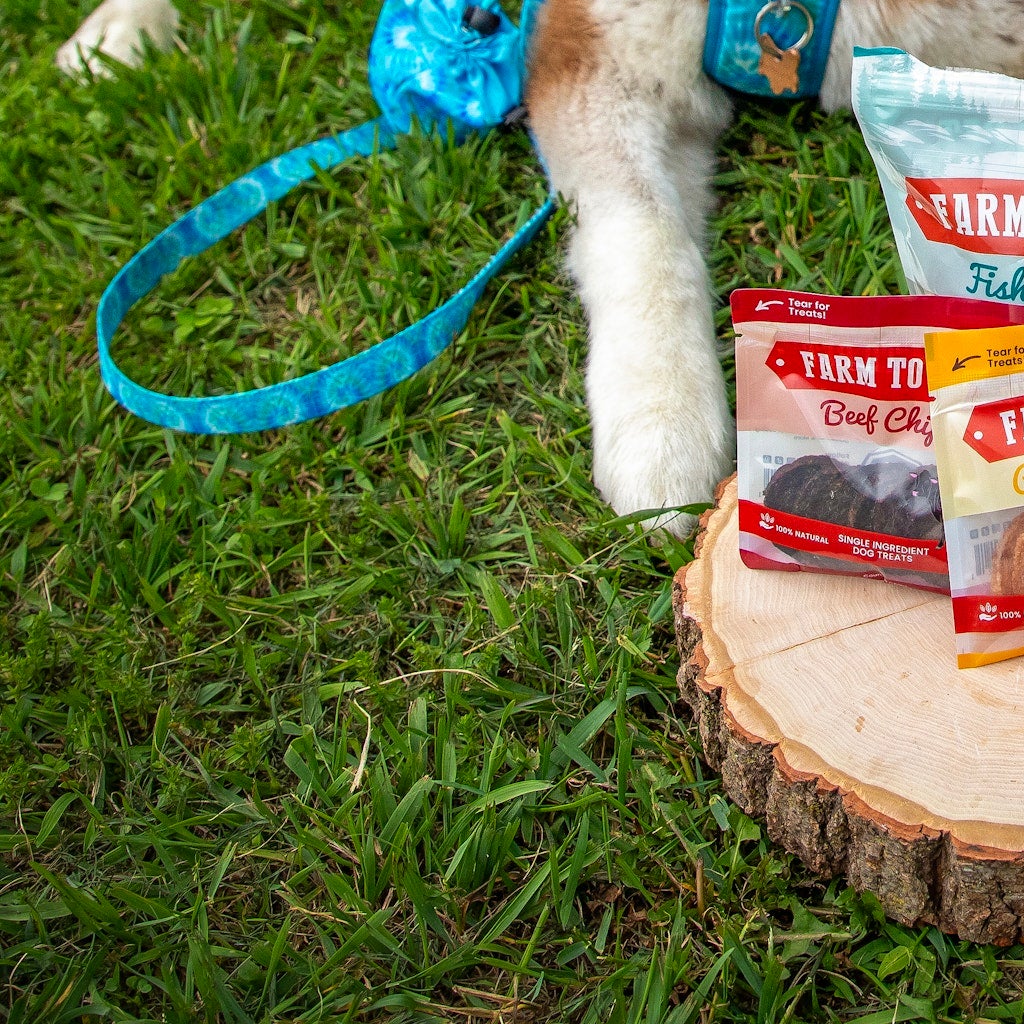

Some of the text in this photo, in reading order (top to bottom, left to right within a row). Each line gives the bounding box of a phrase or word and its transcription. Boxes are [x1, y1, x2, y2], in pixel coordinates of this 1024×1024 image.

[788, 297, 830, 311] Tear for
[788, 307, 827, 320] Treats!
[986, 347, 1012, 358] Tear
[800, 350, 924, 389] FARM TO
[820, 399, 879, 435] Beef
[775, 524, 829, 545] 100% NATURAL
[838, 534, 930, 556] SINGLE INGREDIENT
[852, 547, 913, 563] DOG TREATS
[999, 611, 1021, 619] 100%
